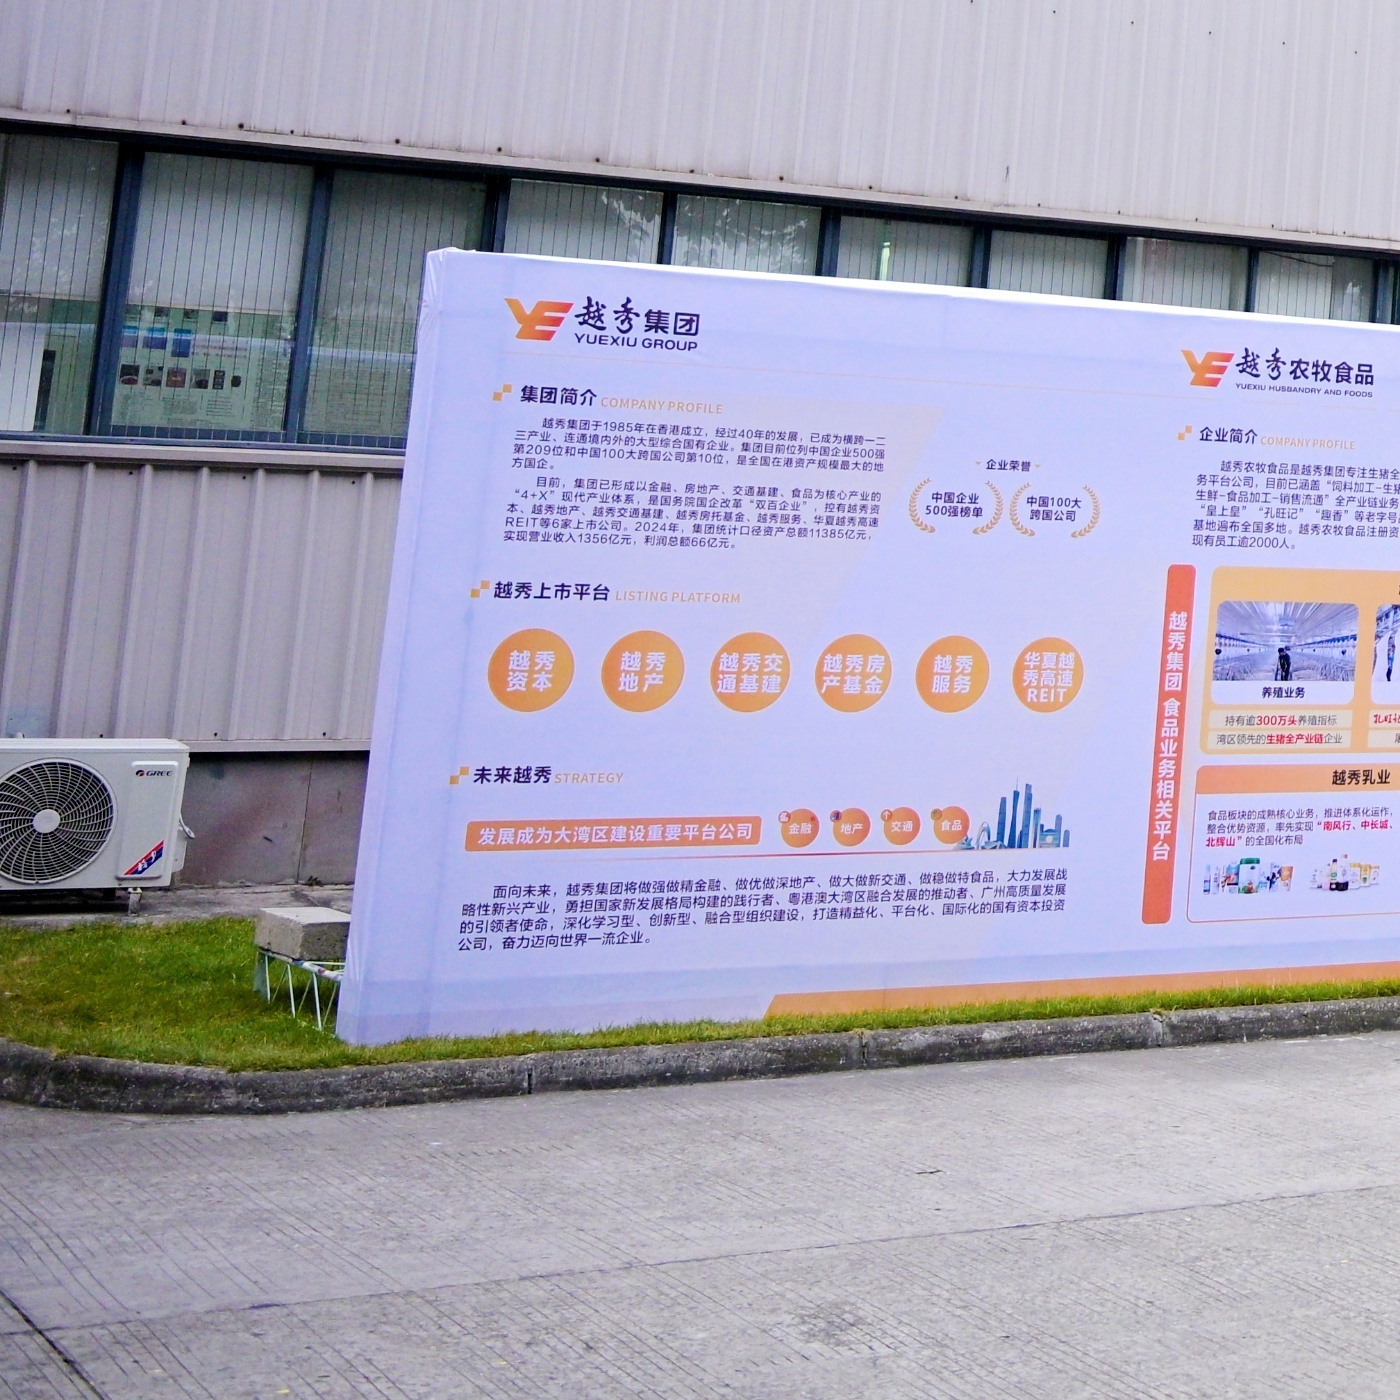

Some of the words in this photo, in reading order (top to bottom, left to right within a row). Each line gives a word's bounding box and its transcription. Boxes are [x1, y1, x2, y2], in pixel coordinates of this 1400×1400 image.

[574, 296, 700, 337] 越秀集团
[574, 332, 638, 349] YUEXIU
[642, 338, 699, 352] GROUP
[1235, 346, 1375, 387] 越秀农牧食品
[520, 384, 598, 407] 集团简介
[1235, 383, 1266, 392] YUEXIU
[1268, 384, 1322, 395] HUSBANDRY
[1323, 388, 1342, 396] AND
[1343, 389, 1373, 398] FOODS
[600, 396, 666, 412] COMPANY
[668, 400, 724, 415] PROFILE
[1199, 425, 1259, 446] 企业简介
[1260, 434, 1311, 449] COMPANY
[1312, 437, 1356, 451] PROFILE
[511, 457, 557, 471] 方国企。
[986, 459, 1032, 473] 企业荣誉
[931, 491, 980, 506] 中国企业
[1026, 495, 1083, 511] 中国100大
[925, 504, 984, 519] 500强榜单
[1029, 508, 1077, 522] 跨国公司
[493, 580, 612, 602] 越秀上市平台
[615, 589, 669, 603] LISTING
[671, 591, 741, 604] PLATFORM
[508, 650, 556, 671] 越秀
[620, 651, 666, 671] 越秀
[718, 652, 783, 673] 越秀交
[823, 653, 885, 674] 越秀房
[933, 654, 973, 674] 越秀
[1024, 652, 1075, 669] 华夏越
[506, 671, 553, 692] 资本
[618, 673, 664, 693] 地产
[716, 673, 781, 694] 通基建
[821, 674, 883, 695] 产基金
[931, 675, 972, 694] 服务
[1022, 669, 1073, 687] 秀高速
[1027, 688, 1067, 703] REIT
[1261, 686, 1306, 699] 养殖业务
[1224, 714, 1338, 727] 持有逾300万头养殖指标
[1216, 732, 1343, 745] 湾区领先的生猪全产业链企业
[473, 765, 552, 786] 未来越秀
[554, 772, 624, 785] STRATEGY
[1331, 768, 1392, 786] 越秀乳业
[477, 822, 754, 847] 发展成为大湾区建设重要平台公司
[788, 820, 813, 835] 金融
[840, 820, 864, 835] 地产
[891, 819, 914, 833] 交通
[940, 818, 964, 833] 食品
[458, 930, 652, 952] 公司，奋力迈向世界一流企业。
